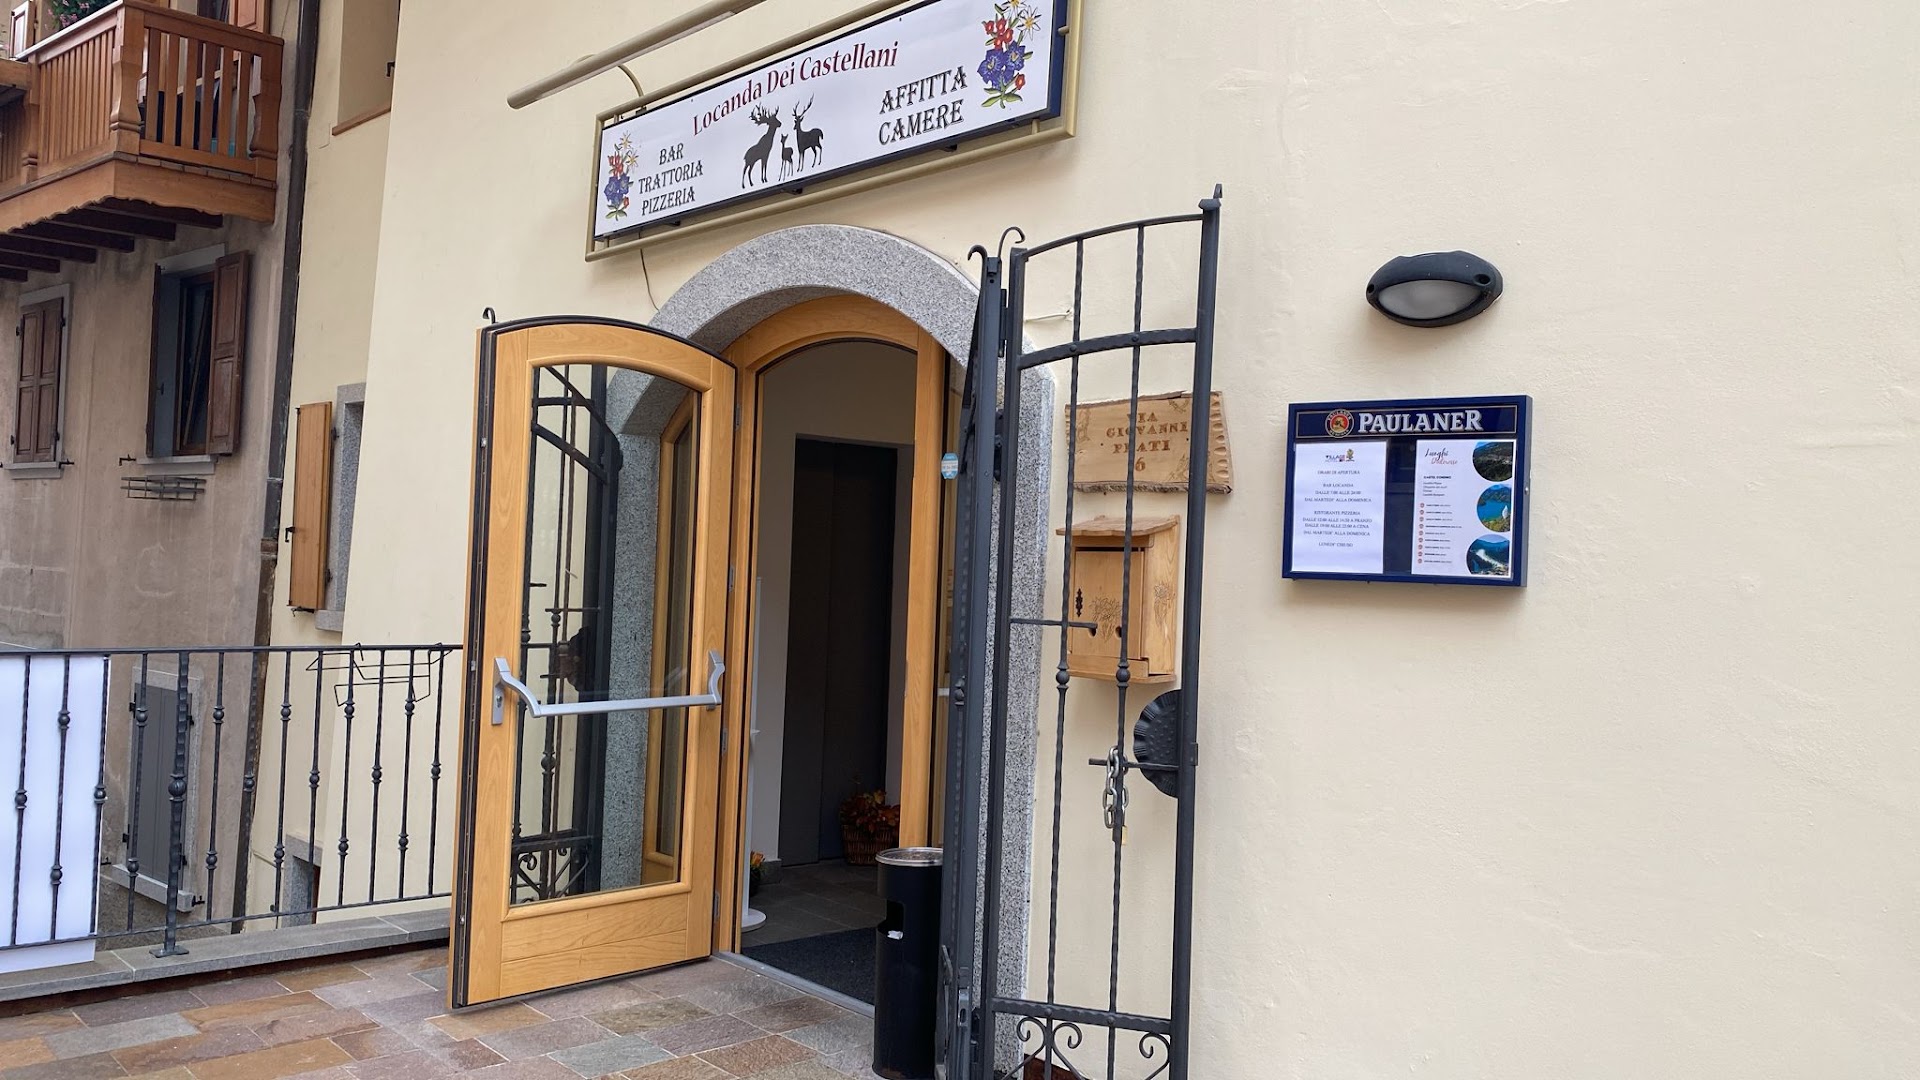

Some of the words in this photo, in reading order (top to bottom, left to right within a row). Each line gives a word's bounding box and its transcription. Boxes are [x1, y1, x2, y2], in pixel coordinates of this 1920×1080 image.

[692, 80, 762, 136] Locanda
[766, 61, 795, 95] Dei
[799, 40, 899, 81] Castellani
[879, 66, 968, 115] AFFITTA
[878, 98, 964, 146] CAMERE
[658, 142, 685, 166] BAR
[638, 159, 704, 195] TRATTORIA
[641, 185, 696, 217] PIZZERIA
[1358, 409, 1484, 434] PAULANER
[1135, 457, 1146, 472] 6
